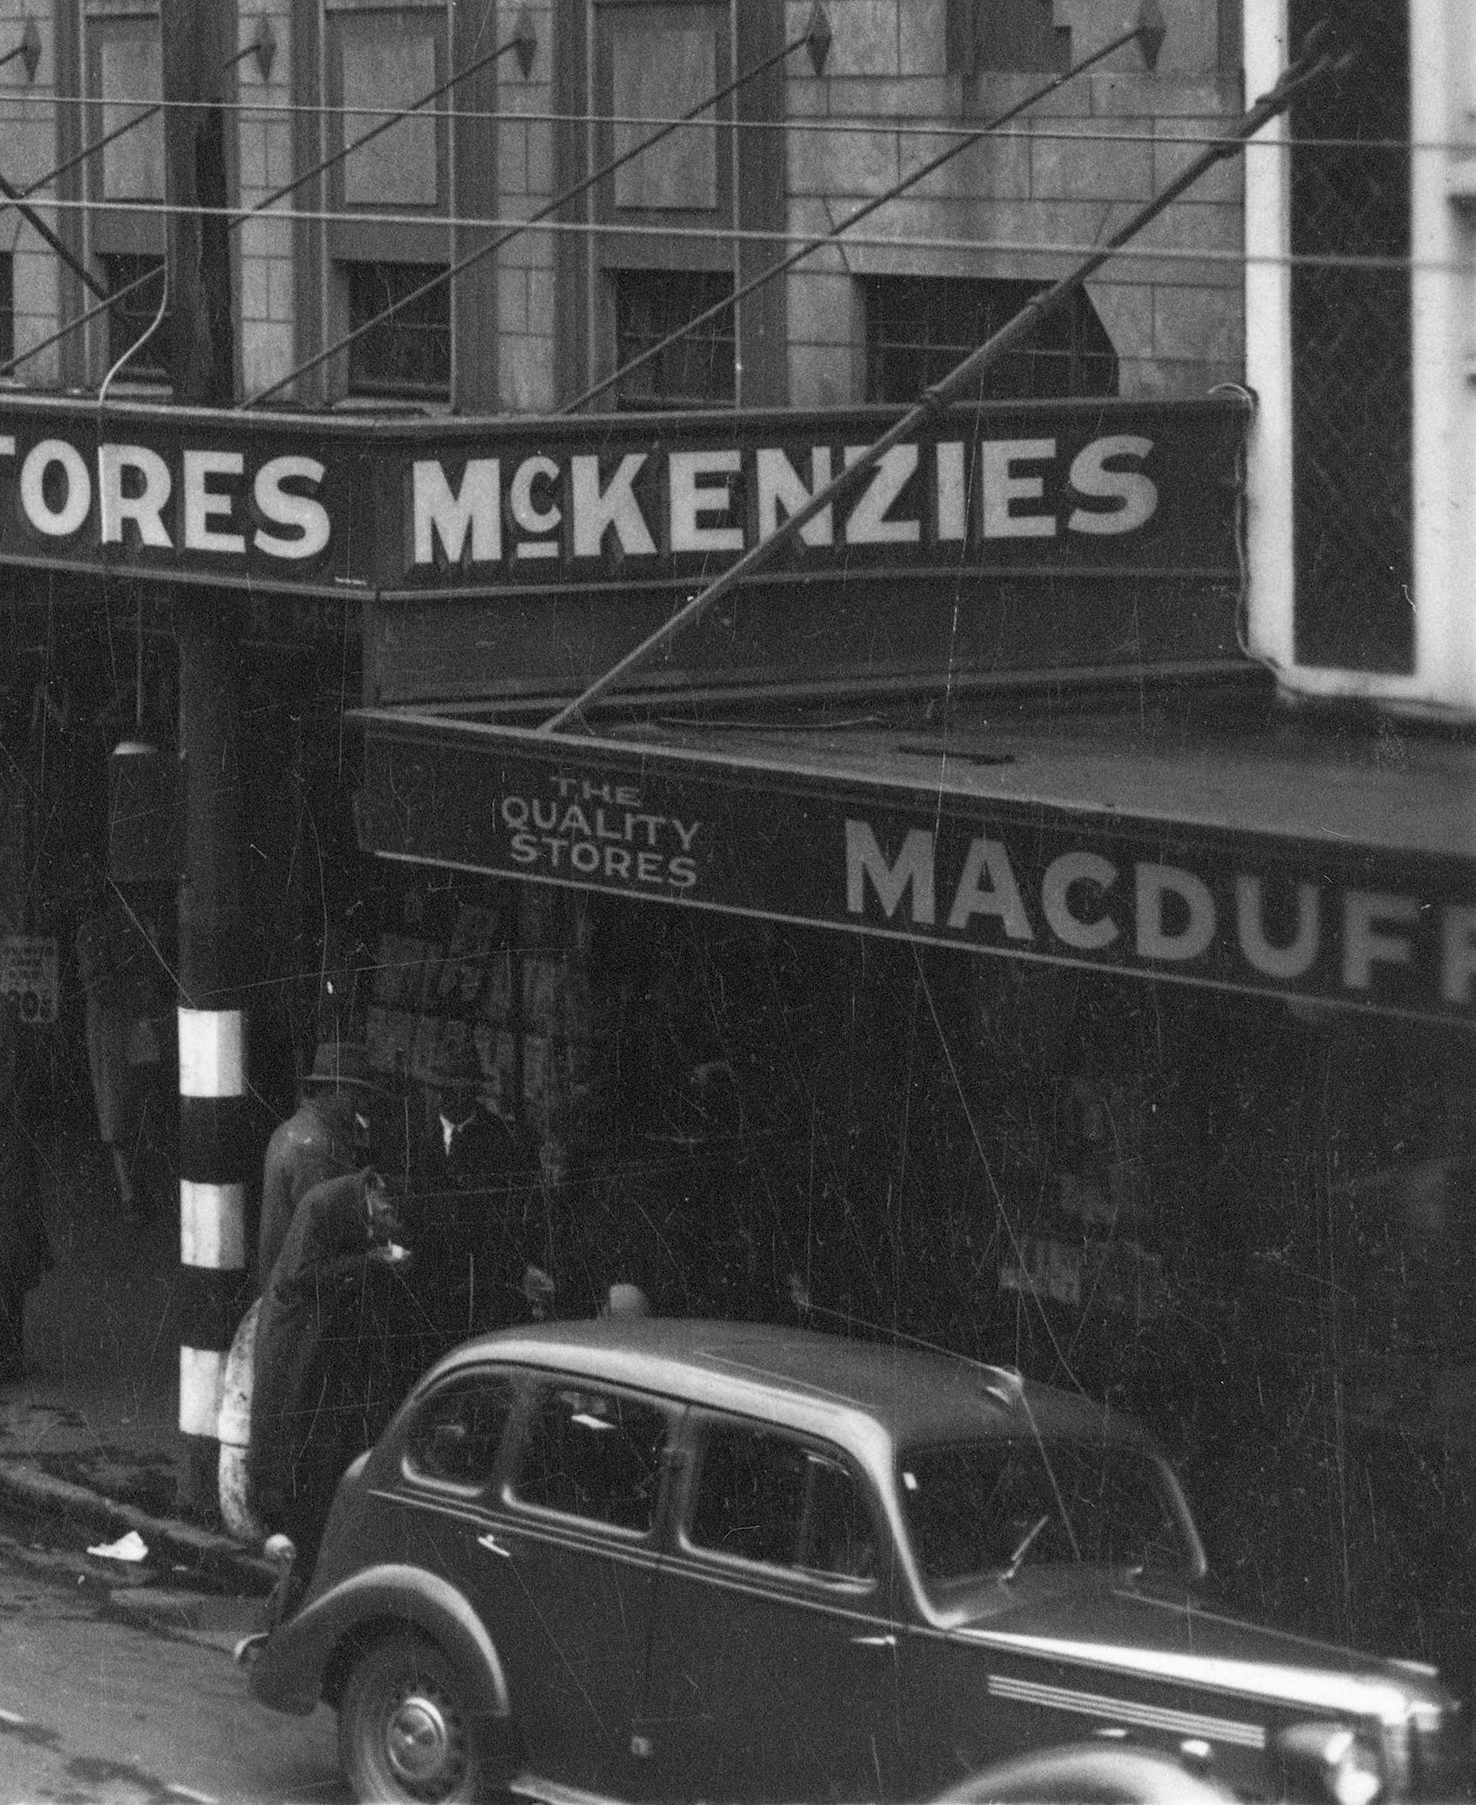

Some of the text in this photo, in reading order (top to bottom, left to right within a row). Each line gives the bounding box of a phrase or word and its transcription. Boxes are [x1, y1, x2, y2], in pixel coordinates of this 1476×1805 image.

[411, 434, 1160, 565] McKENZIES
[549, 774, 643, 808] THE
[500, 795, 702, 852] QUALITY
[510, 832, 698, 888] STORES
